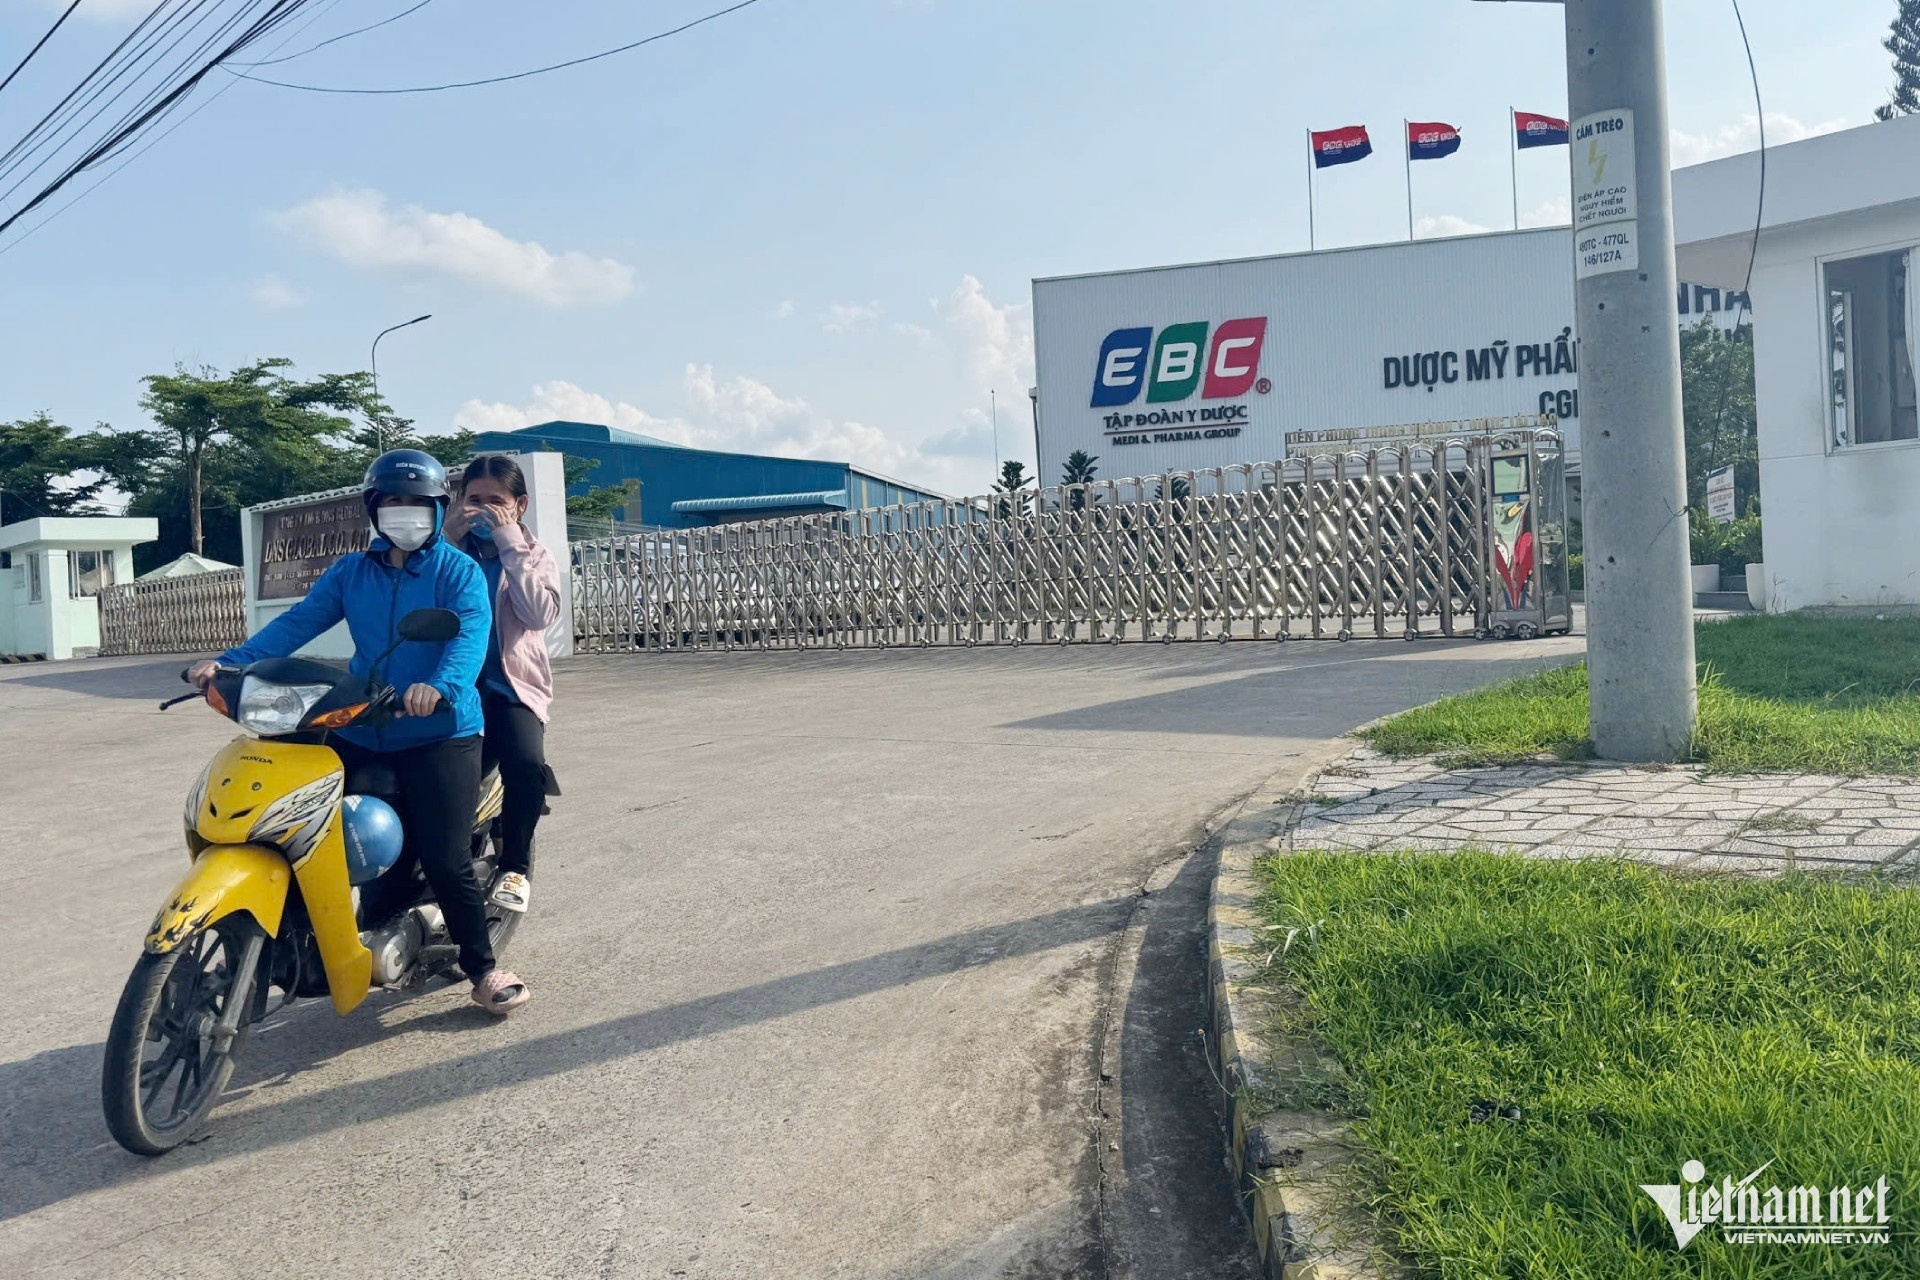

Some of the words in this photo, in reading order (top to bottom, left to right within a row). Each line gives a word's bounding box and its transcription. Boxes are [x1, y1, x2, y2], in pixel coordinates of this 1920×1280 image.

[1607, 185, 1627, 197] CAO
[1580, 200, 1599, 213] NGUY
[1602, 232, 1630, 247] 477QL
[1583, 249, 1622, 268] 146/127A
[1100, 334, 1258, 389] EBC
[1383, 350, 1459, 393] DƯỢC
[1466, 339, 1509, 382] MỸ
[1103, 412, 1133, 430] TẬP
[1136, 408, 1183, 426] ĐOÀN
[1185, 409, 1198, 423] Y
[1201, 404, 1248, 423] DƯỢC
[1112, 433, 1139, 447] MEDI
[1140, 434, 1152, 444] &
[1154, 430, 1202, 443] PHARMA
[1204, 426, 1241, 439] GROUP
[264, 537, 285, 564] DNS
[239, 755, 274, 766] HONDA
